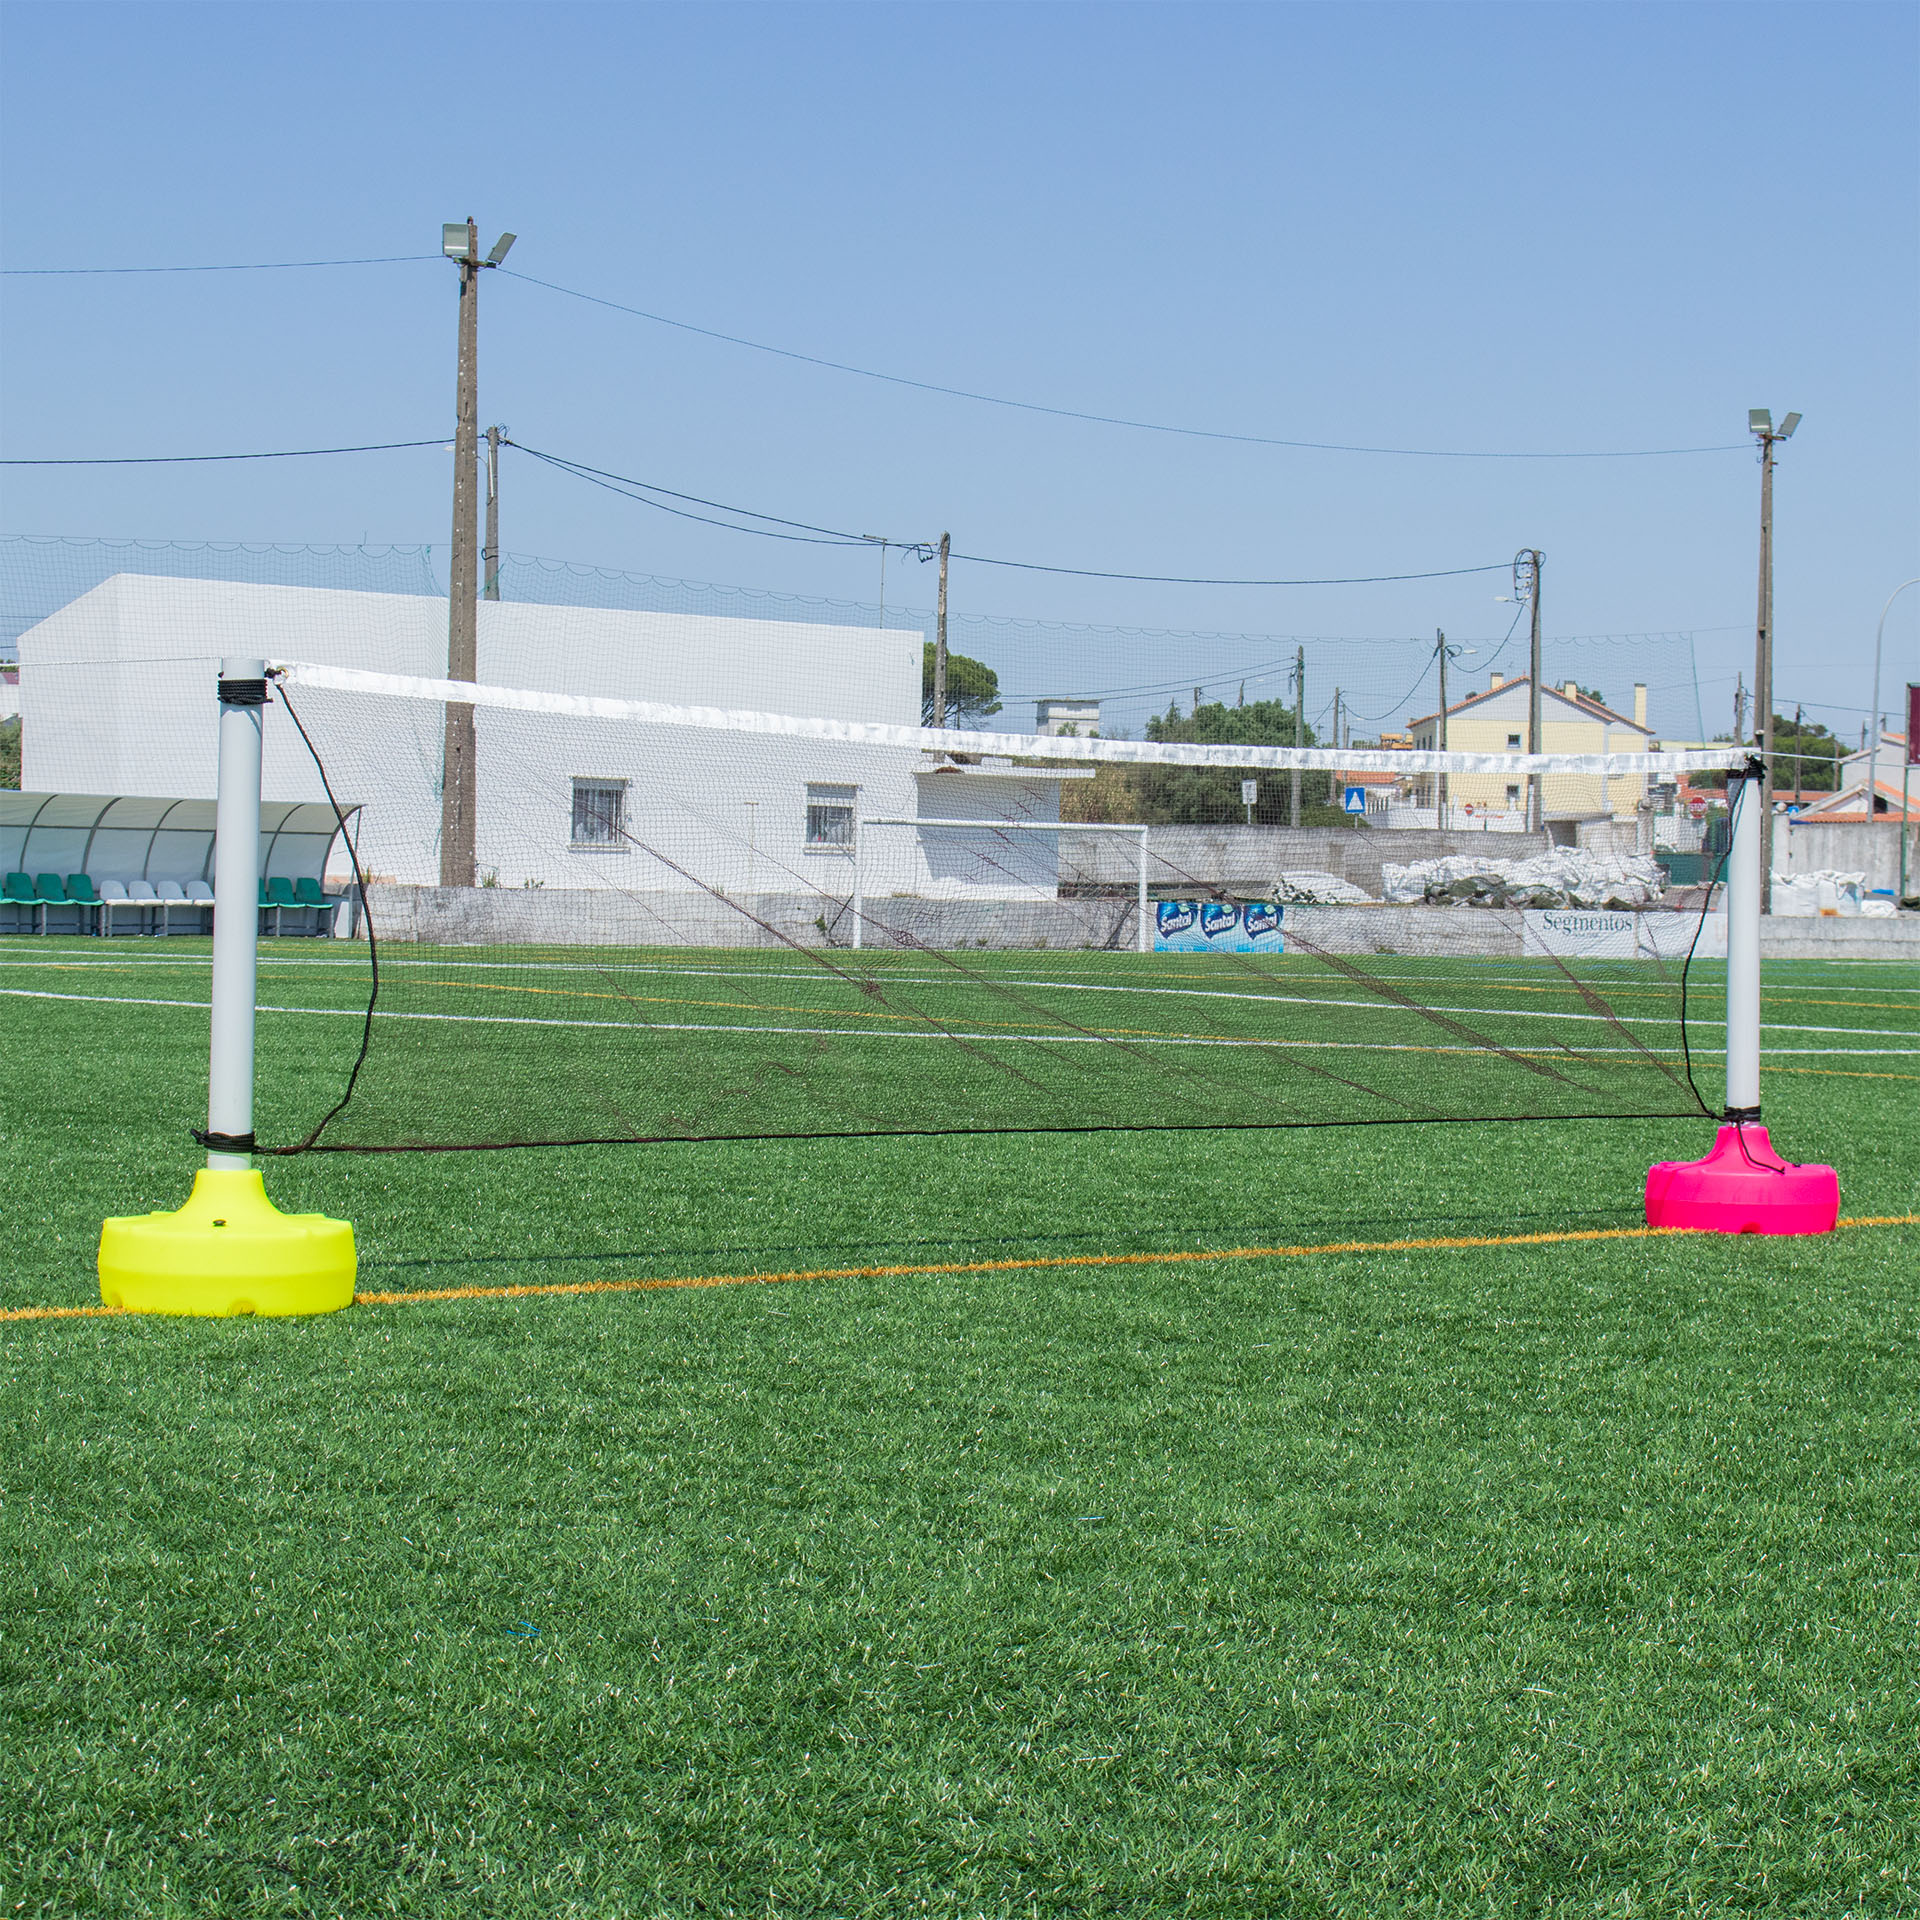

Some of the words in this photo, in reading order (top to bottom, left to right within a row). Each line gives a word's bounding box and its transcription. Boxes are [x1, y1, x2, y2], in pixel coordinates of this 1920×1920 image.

[1160, 912, 1192, 932] Santal
[1204, 912, 1235, 932] Santal
[1543, 911, 1632, 936] Segmentos
